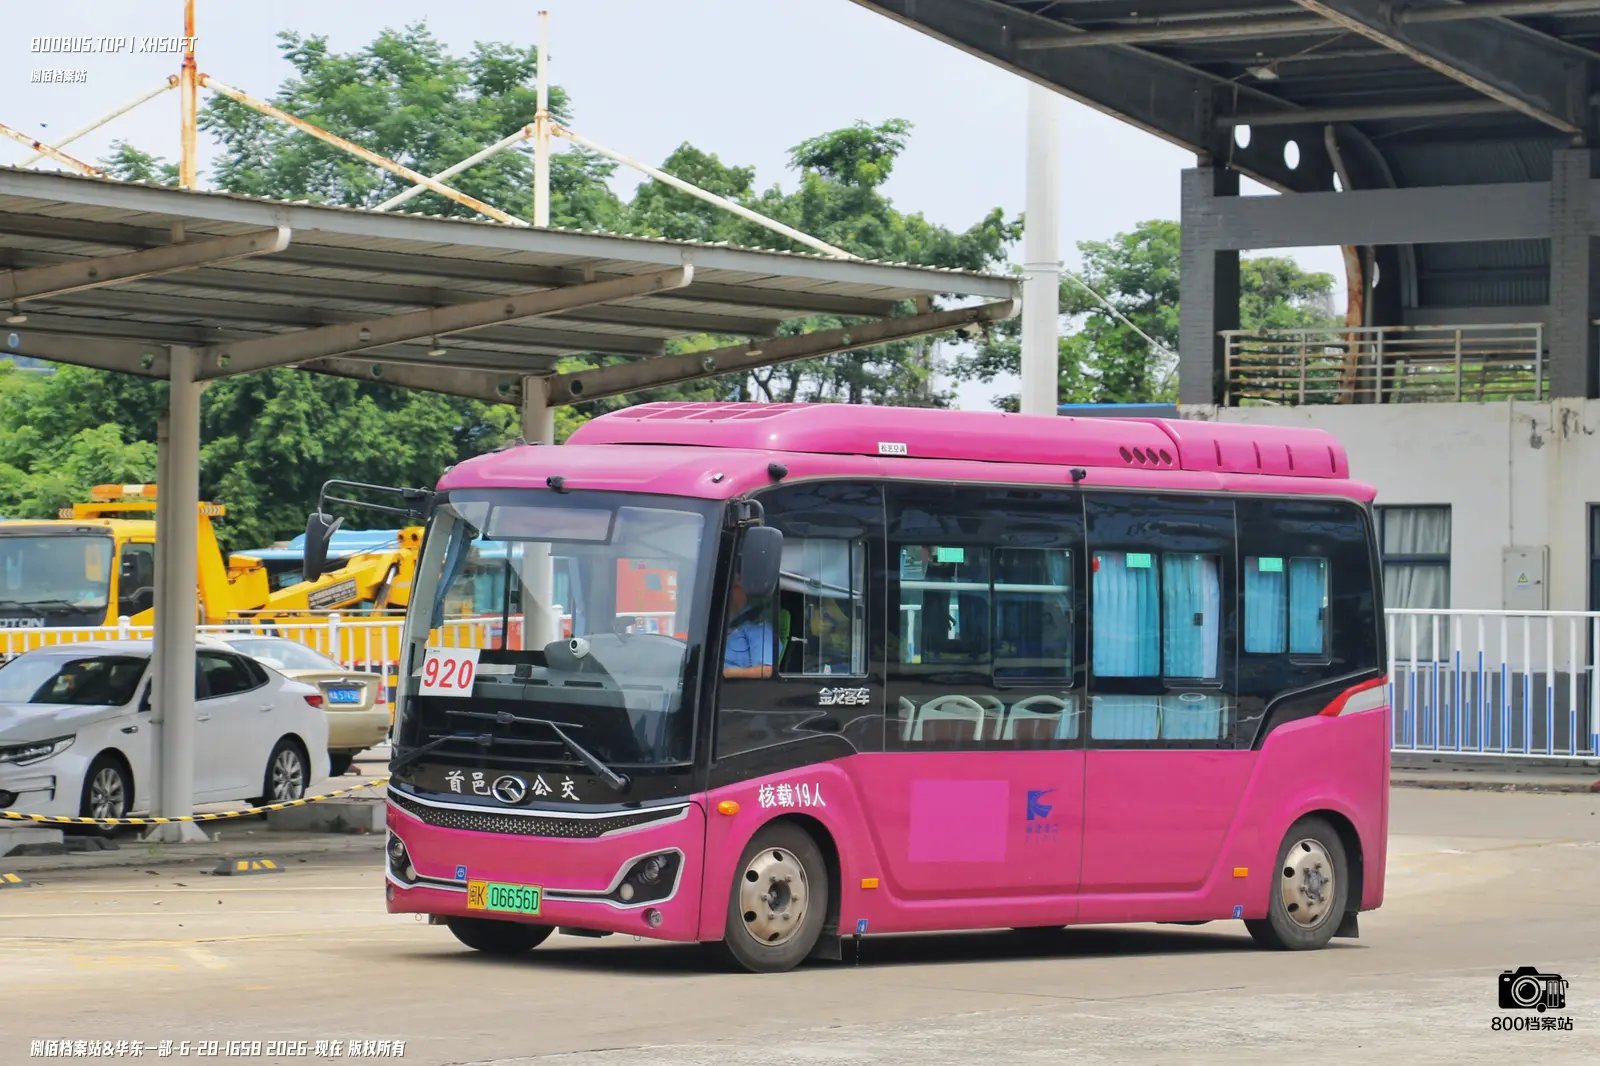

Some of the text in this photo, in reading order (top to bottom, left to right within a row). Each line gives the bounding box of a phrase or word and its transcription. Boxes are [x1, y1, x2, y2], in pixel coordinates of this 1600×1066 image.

[423, 657, 474, 689] 920
[818, 687, 870, 705] 金龙客车
[444, 770, 581, 801] 首邑 公交
[758, 782, 826, 808] 核载19人
